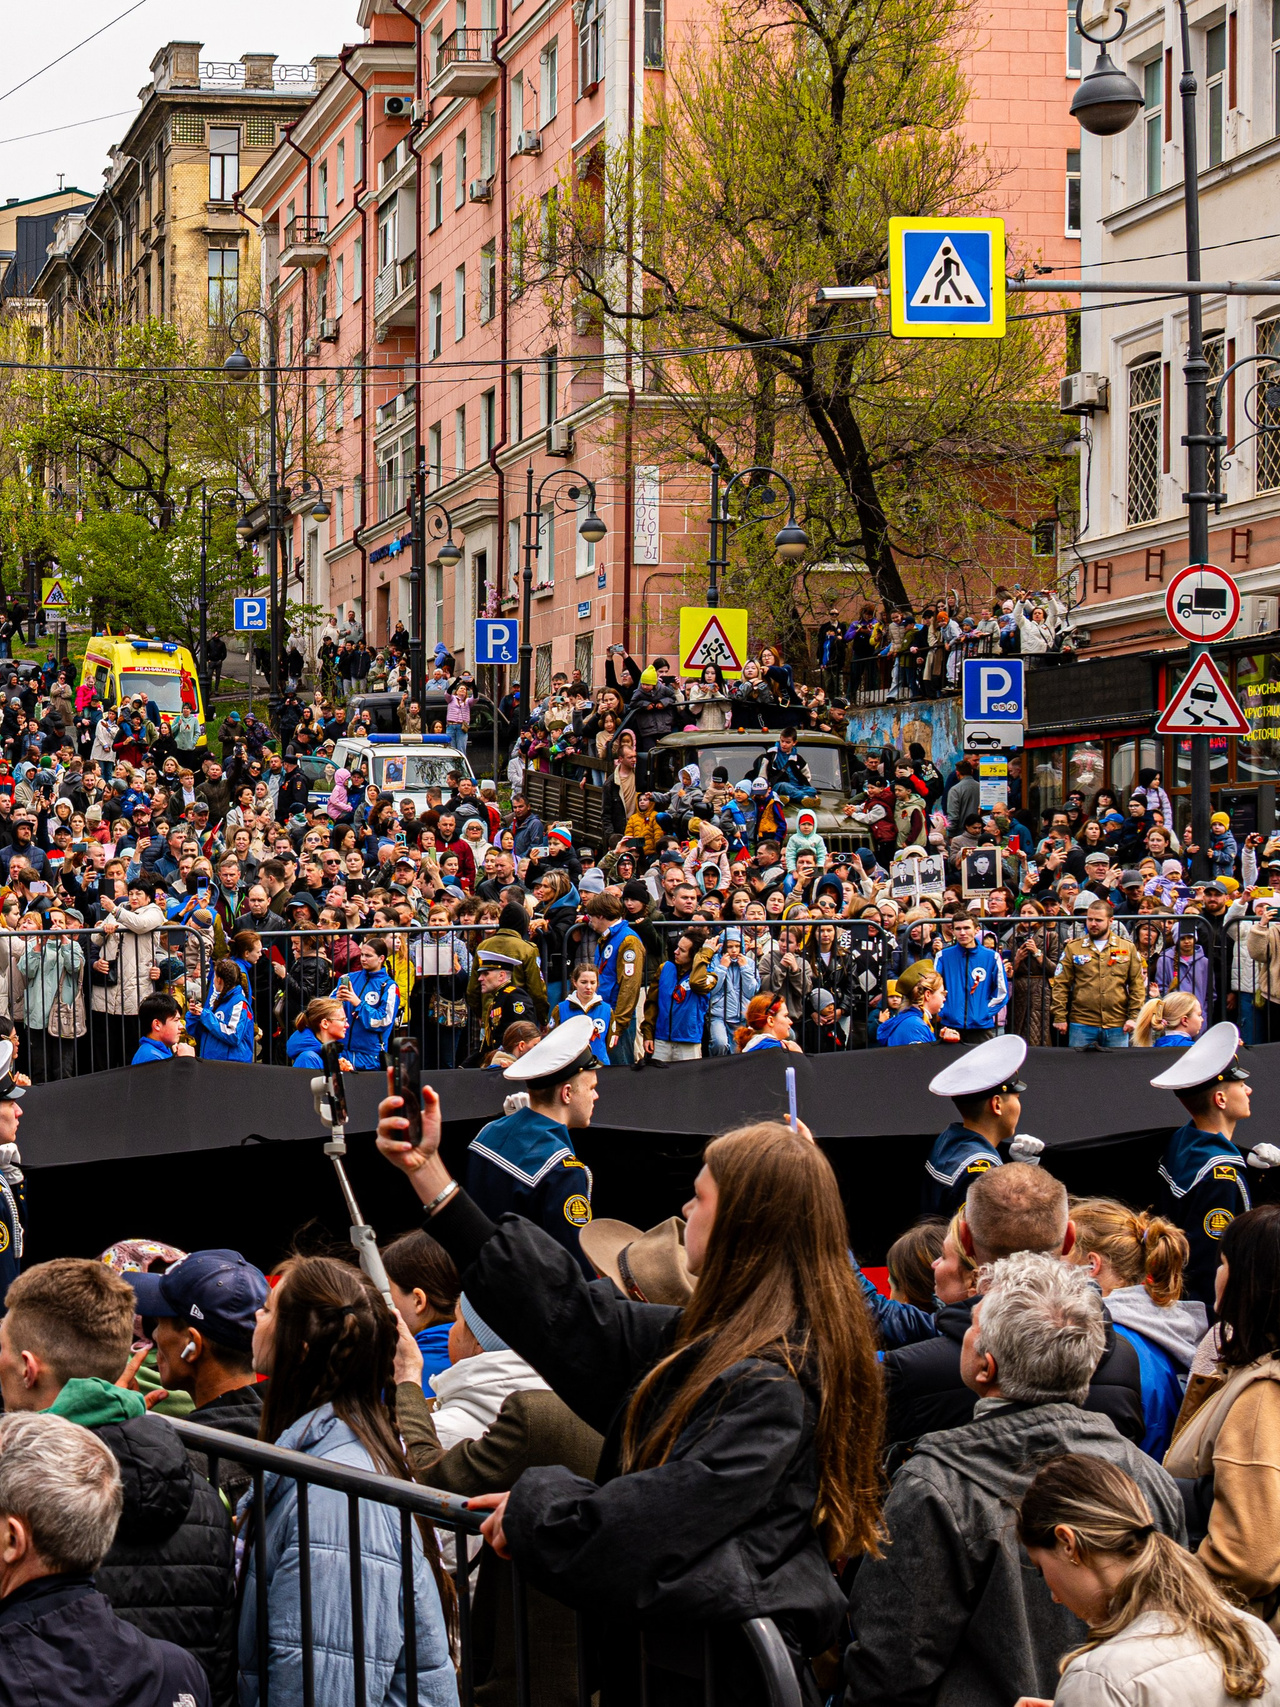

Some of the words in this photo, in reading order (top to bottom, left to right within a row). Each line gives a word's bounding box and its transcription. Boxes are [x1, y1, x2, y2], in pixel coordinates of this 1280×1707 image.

[644, 474, 658, 560] РАСОТЫ
[980, 667, 1012, 714] P
[1007, 703, 1018, 711] 20
